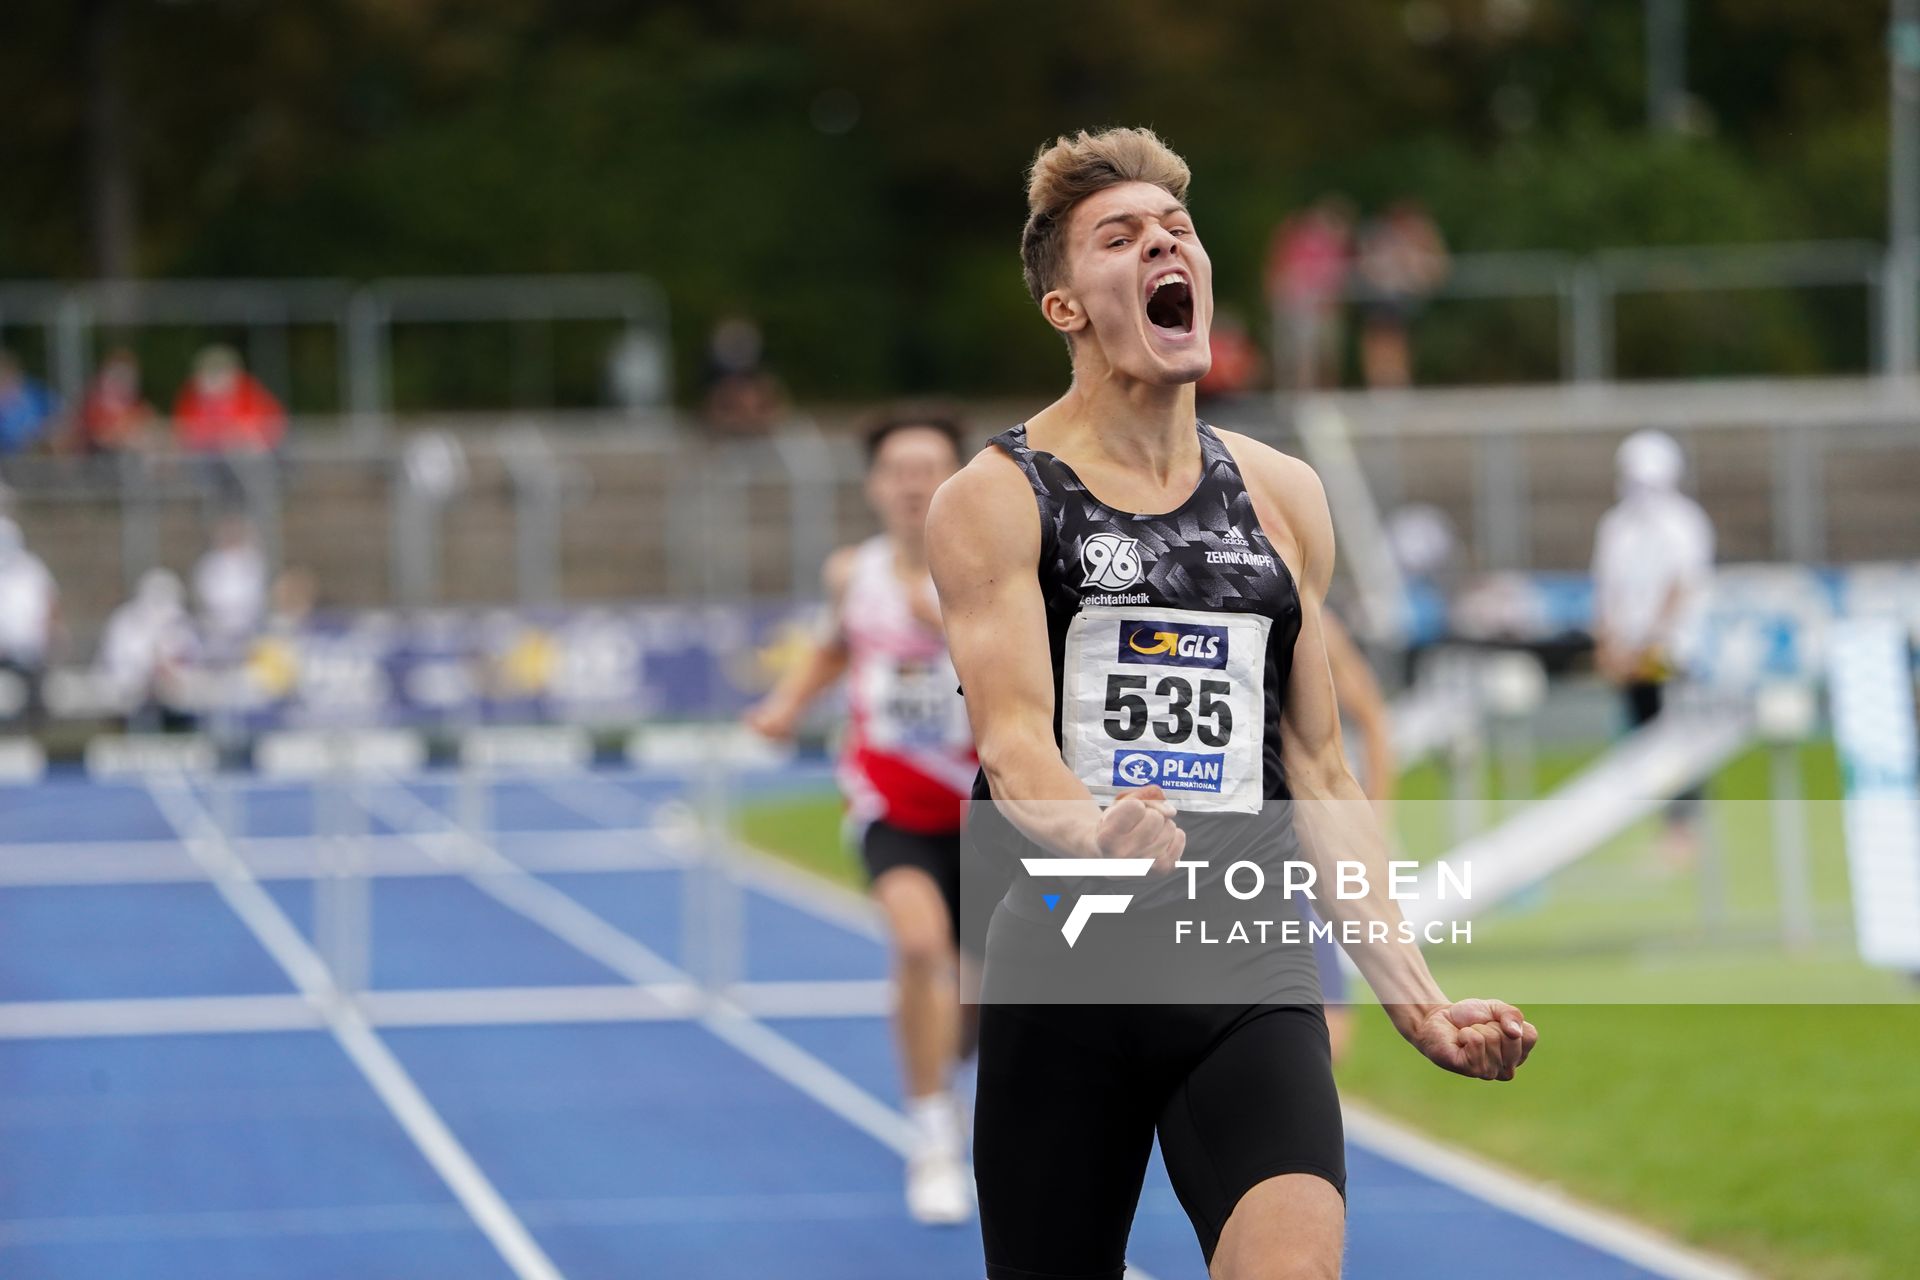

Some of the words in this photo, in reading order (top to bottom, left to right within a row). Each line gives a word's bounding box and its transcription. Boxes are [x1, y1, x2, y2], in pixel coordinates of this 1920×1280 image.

[1222, 537, 1249, 546] adidas
[1085, 540, 1138, 582] 96
[1205, 551, 1271, 567] ZEHNKAMPF
[1178, 634, 1220, 659] GLS
[1103, 674, 1233, 747] 535
[1163, 759, 1219, 780] PLAN
[1162, 780, 1216, 790] INTERNATIONAL
